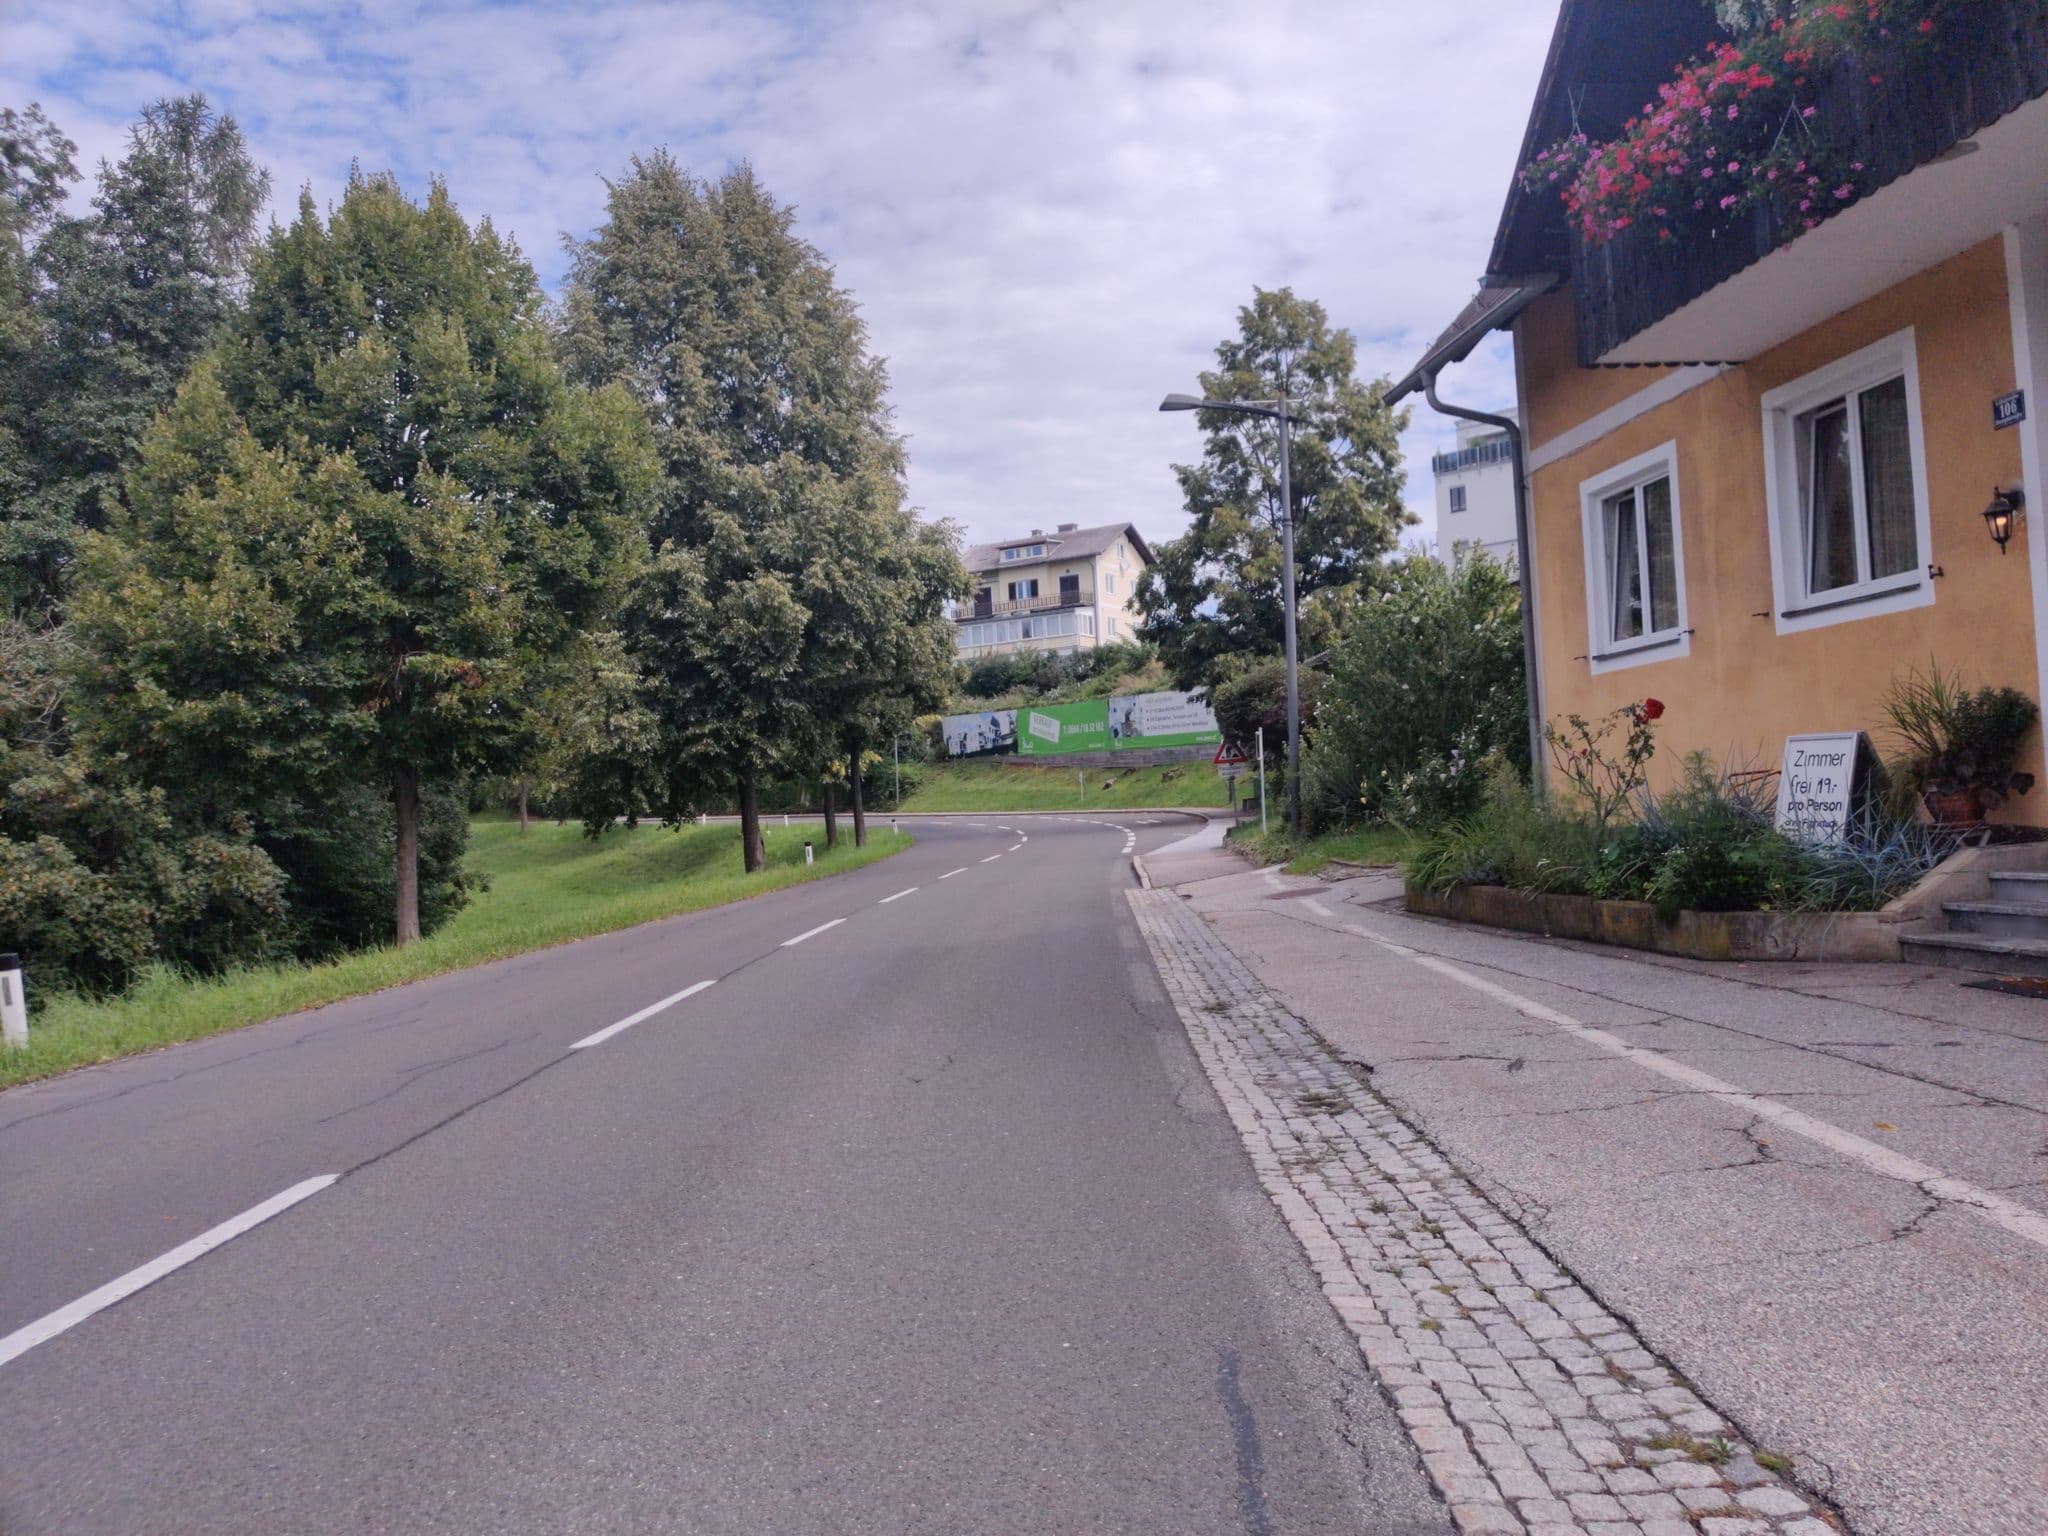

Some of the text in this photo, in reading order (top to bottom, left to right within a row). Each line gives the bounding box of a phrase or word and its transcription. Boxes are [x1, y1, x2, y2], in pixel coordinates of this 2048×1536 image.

[2000, 400, 2018, 418] 106
[1794, 750, 1846, 767] Zimmer
[1790, 774, 1812, 793] frei
[1788, 799, 1842, 814] pro Person
